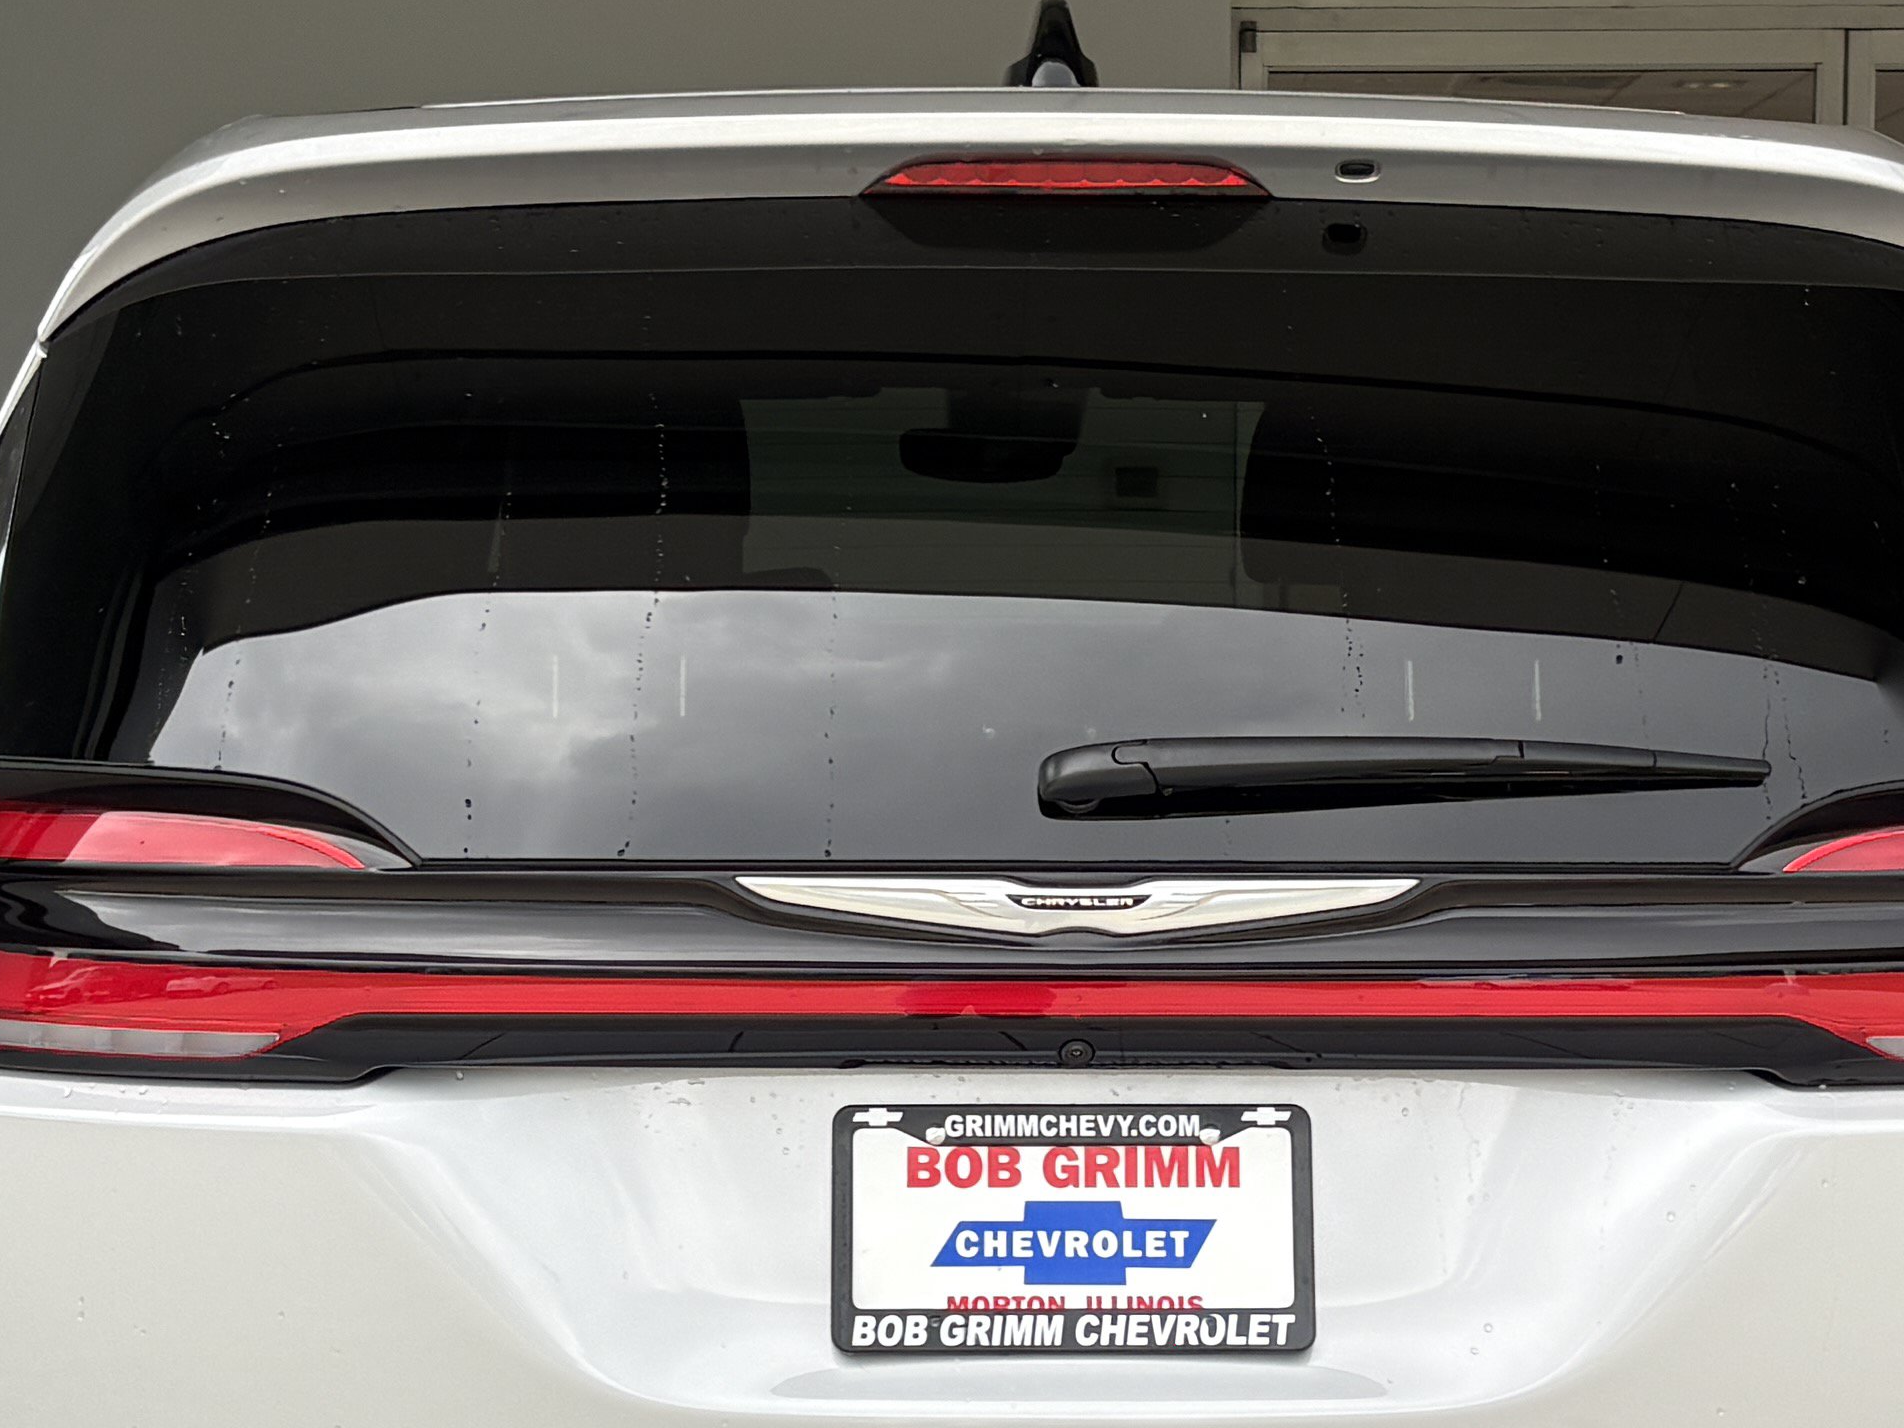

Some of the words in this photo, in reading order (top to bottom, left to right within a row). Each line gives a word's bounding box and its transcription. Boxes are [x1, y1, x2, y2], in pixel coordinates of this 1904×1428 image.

[1020, 897, 1134, 907] CHRYSLER
[943, 1113, 1201, 1139] GRIMMCHEVY.COM
[907, 1146, 1022, 1189] BOB
[1042, 1145, 1241, 1189] GRIMM
[954, 1229, 1191, 1259] CHEVROLET
[851, 1315, 928, 1347] BOB
[939, 1315, 1062, 1347] GRIMM
[1075, 1314, 1296, 1347] CHEVROLET
